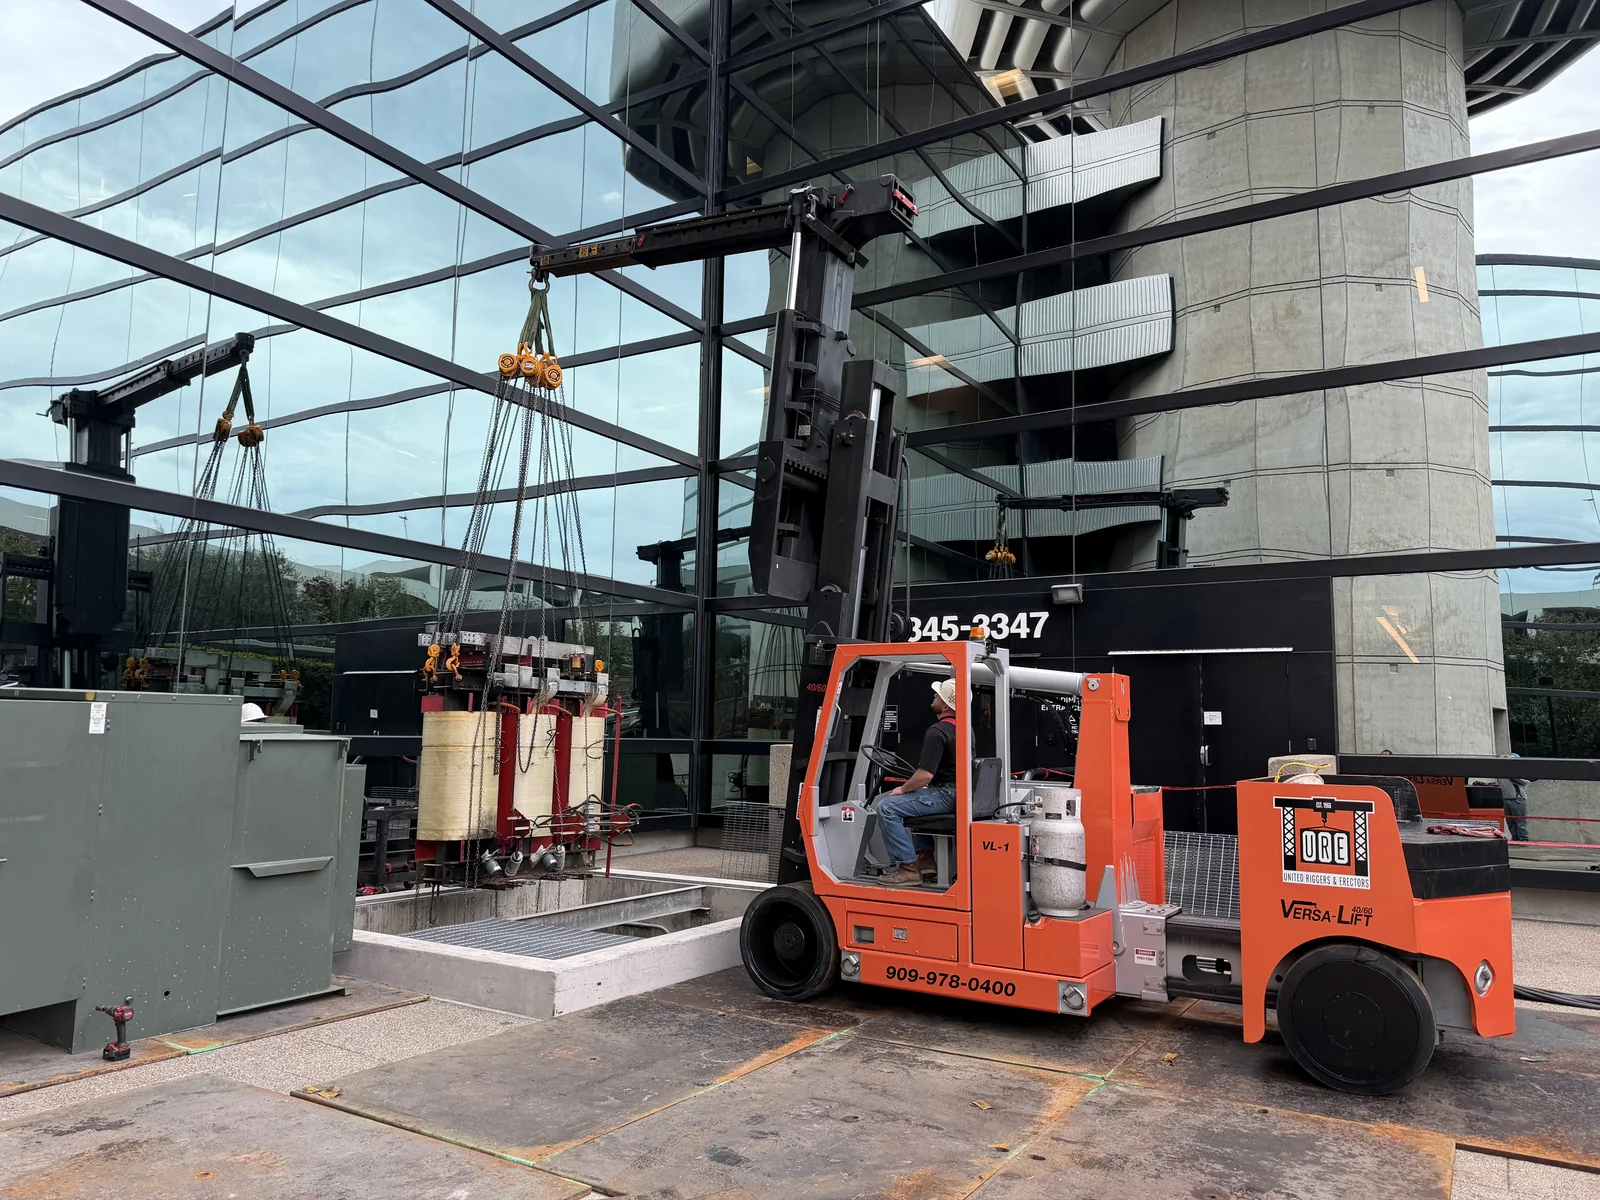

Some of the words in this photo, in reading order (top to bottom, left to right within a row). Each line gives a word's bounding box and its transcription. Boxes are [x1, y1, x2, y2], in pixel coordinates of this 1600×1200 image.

[806, 682, 827, 693] 40/60
[982, 841, 1010, 852] VL-1
[1304, 832, 1347, 862] URE
[1283, 872, 1304, 883] UNITED
[1305, 874, 1331, 885] RIGGERS
[1333, 876, 1338, 886] &
[1339, 877, 1370, 888] ERECTORS
[1352, 906, 1373, 915] 40/60
[886, 966, 1017, 997] 909-978-0400
